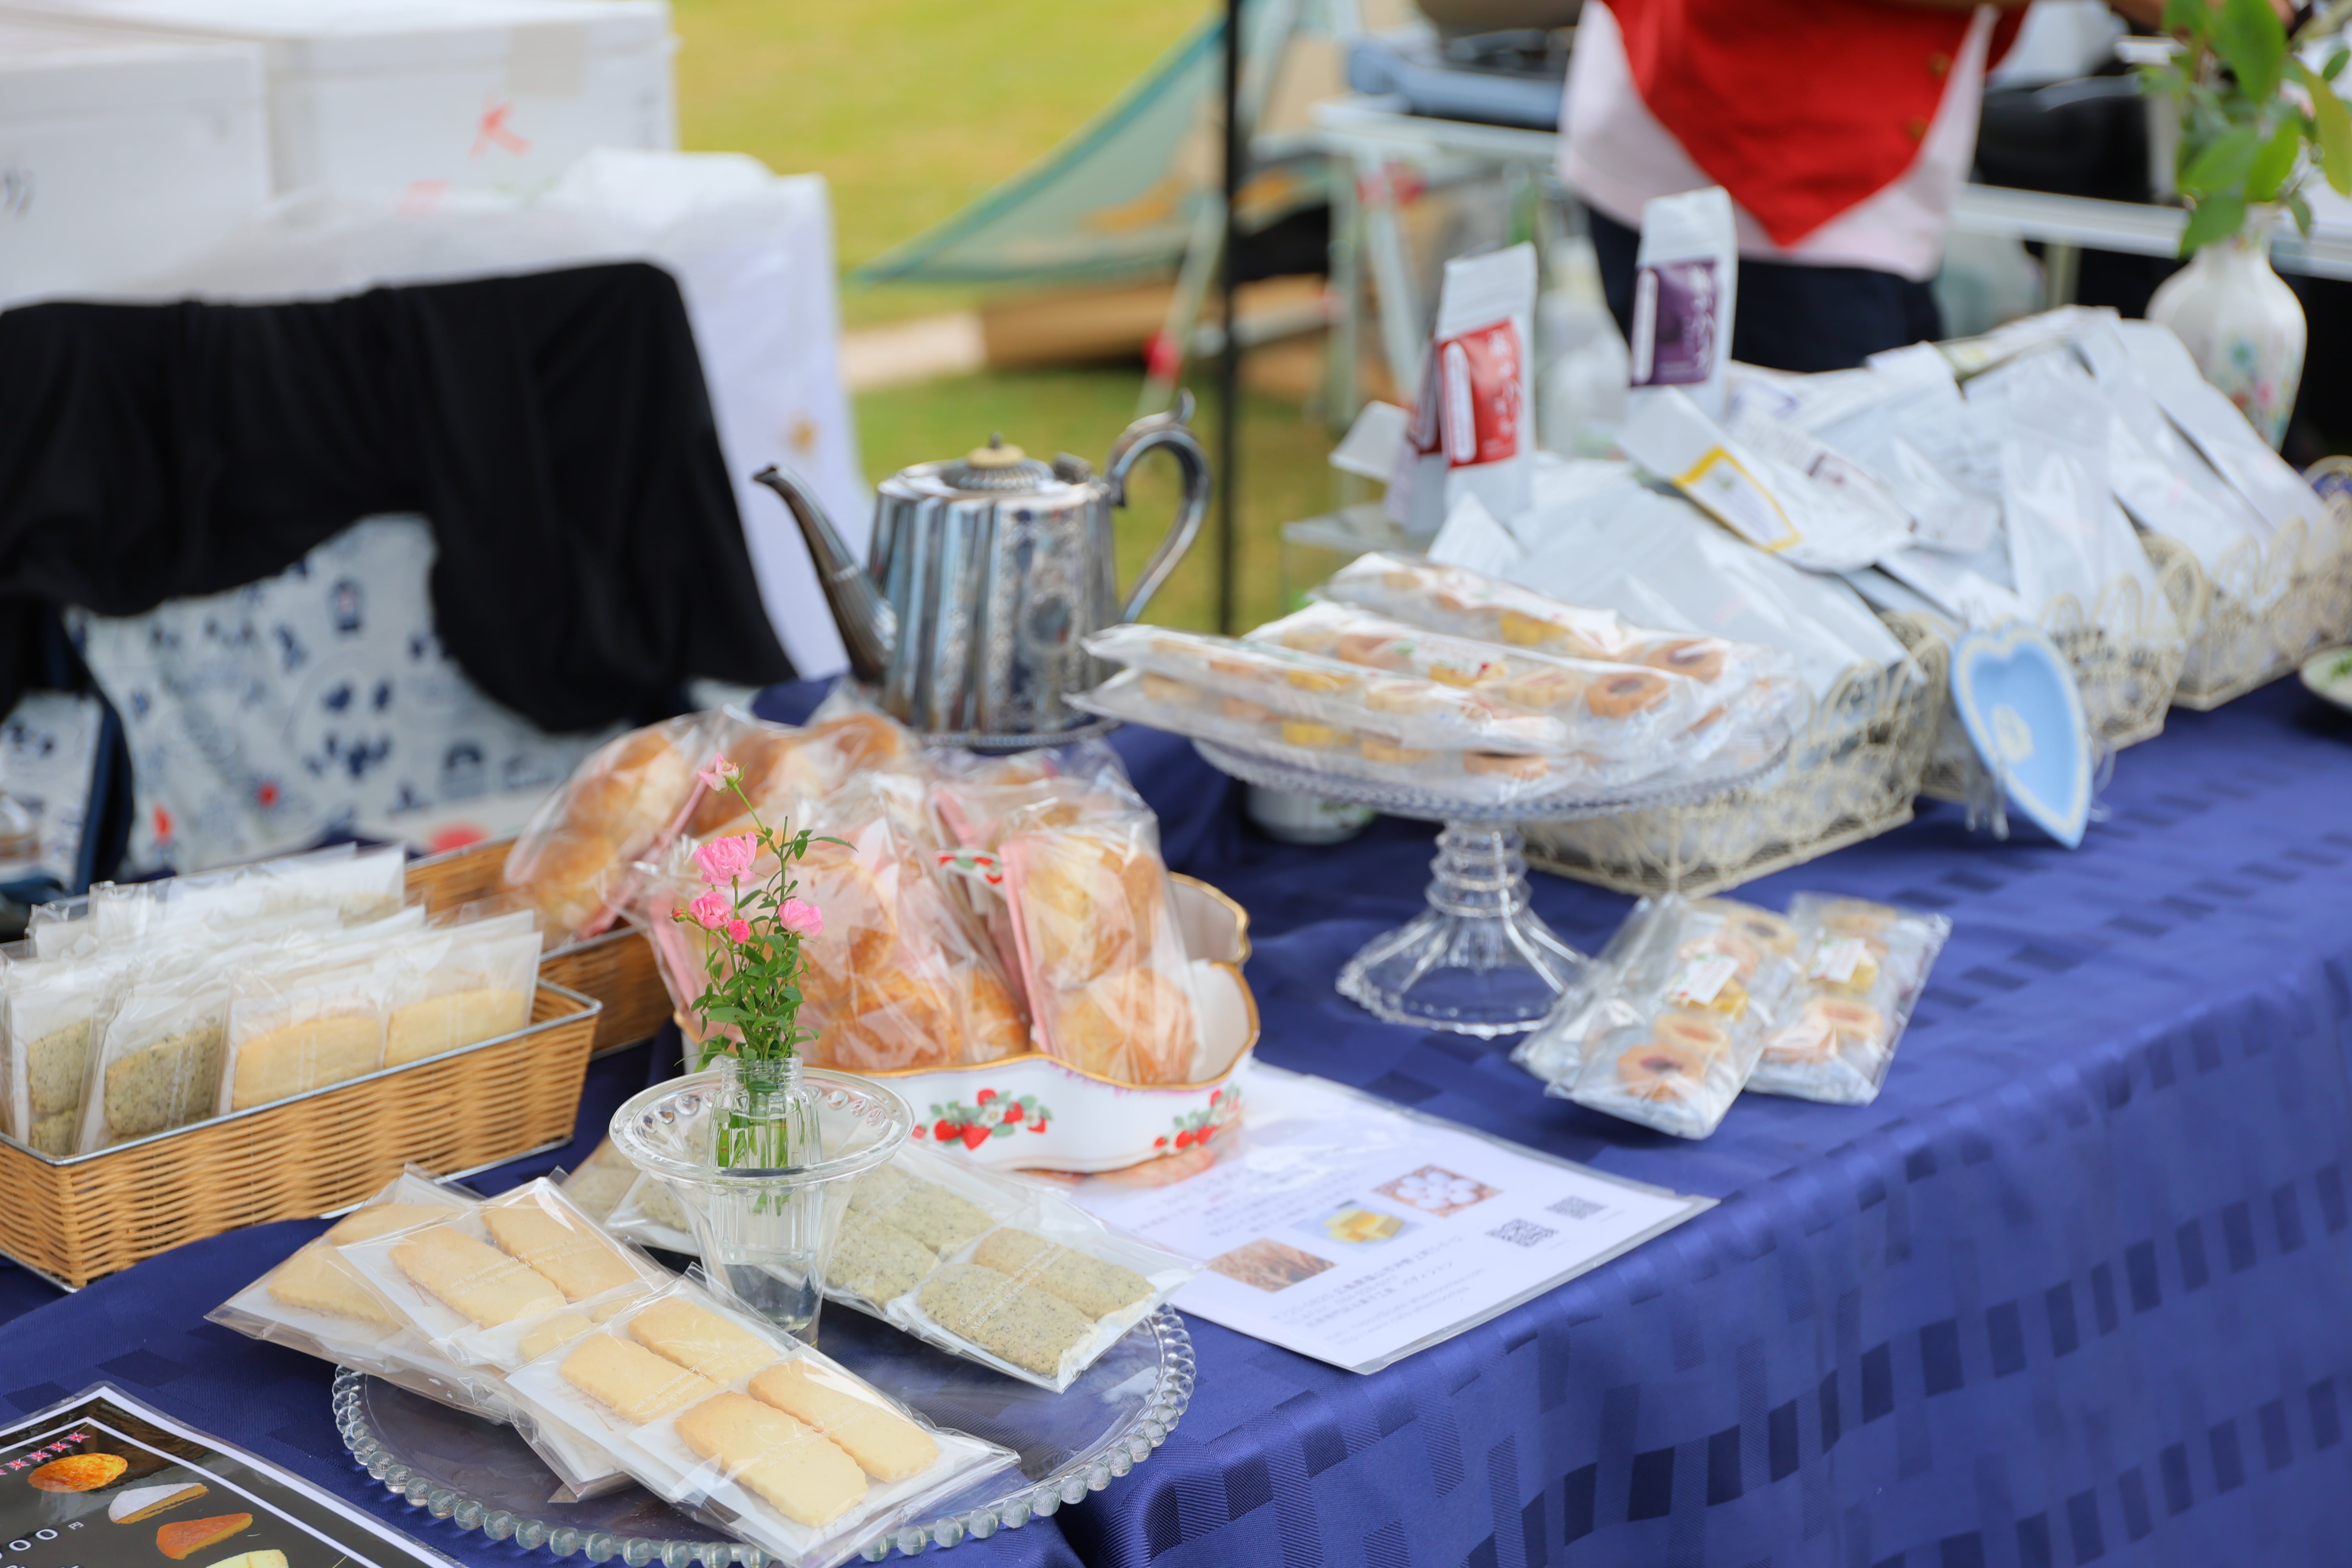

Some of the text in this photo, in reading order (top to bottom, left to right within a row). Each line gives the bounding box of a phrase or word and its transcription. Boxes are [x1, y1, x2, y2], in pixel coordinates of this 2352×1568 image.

[464, 1273, 476, 1283] de
[485, 1275, 497, 1285] de
[958, 1312, 973, 1327] Ce
[969, 1292, 995, 1316] moment
[993, 1284, 1005, 1295] est
[969, 1313, 990, 1332] Mon
[688, 1363, 701, 1375] de
[645, 1392, 657, 1404] de
[666, 1393, 678, 1405] de
[654, 1399, 668, 1411] ma
